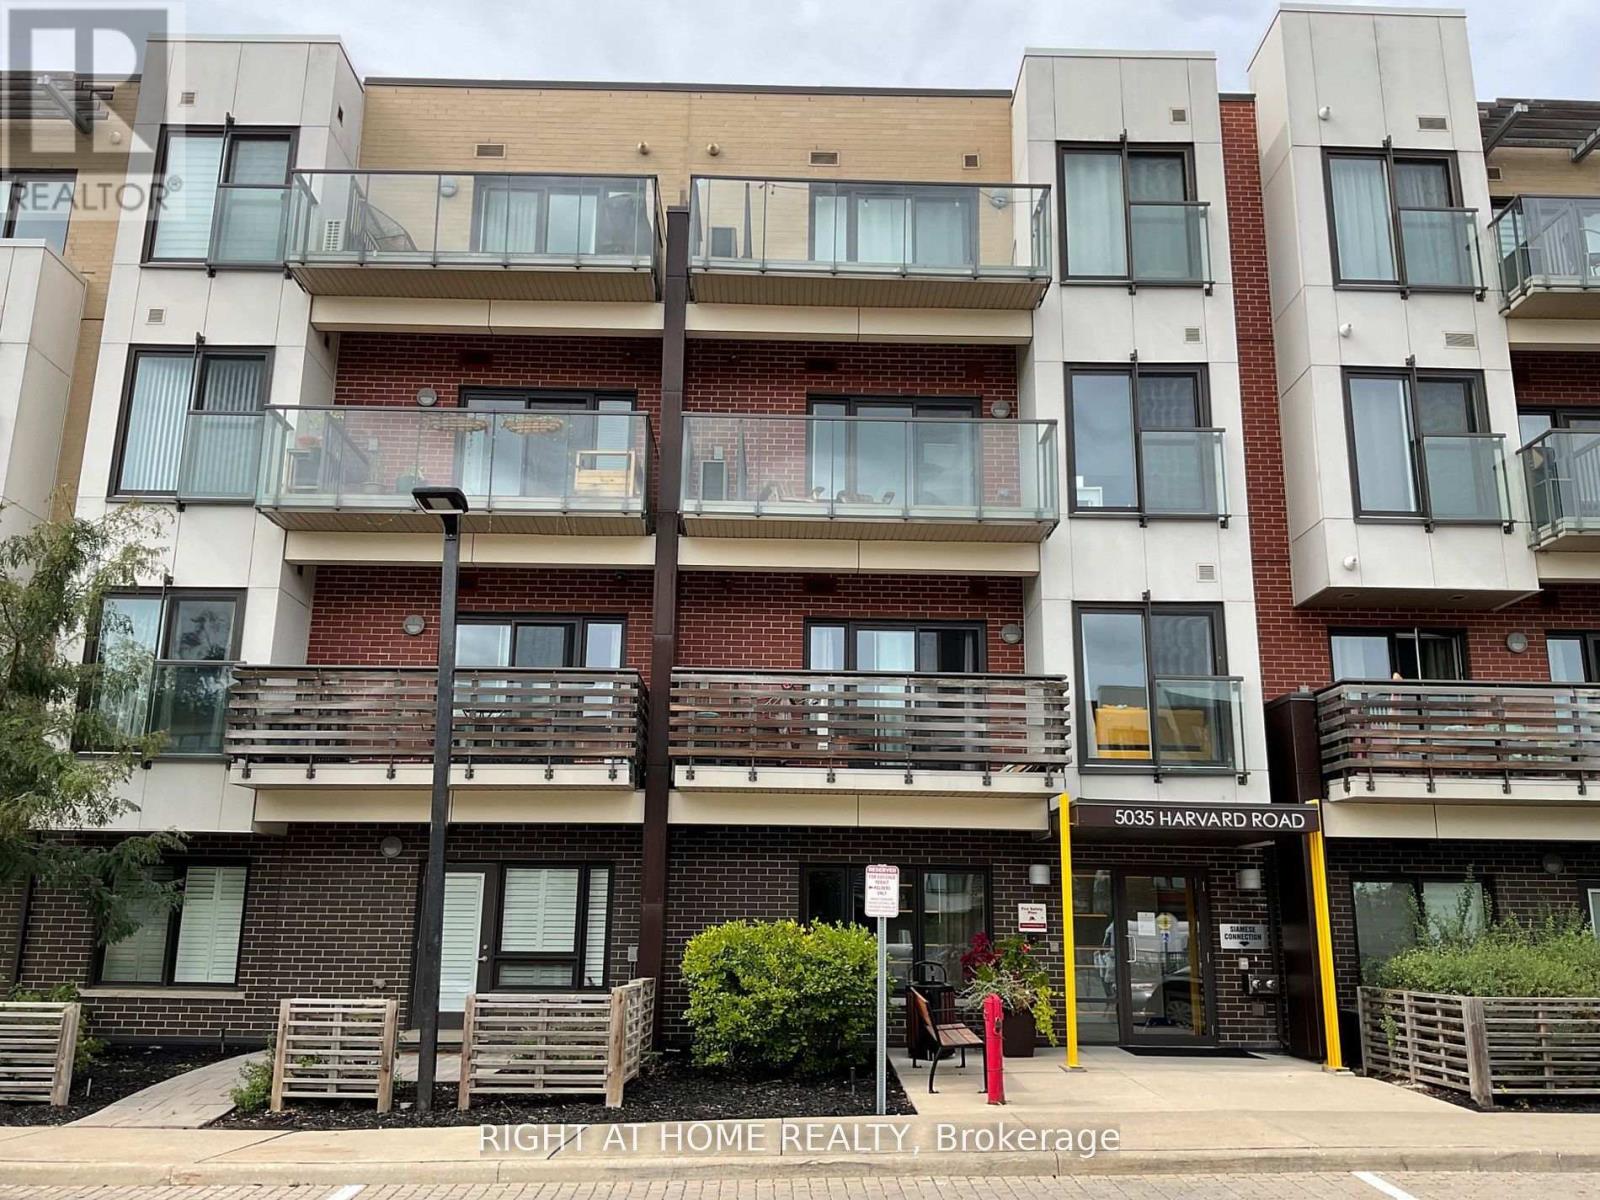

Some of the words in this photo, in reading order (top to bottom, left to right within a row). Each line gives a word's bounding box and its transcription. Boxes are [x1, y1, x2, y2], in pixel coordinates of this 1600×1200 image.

[1114, 809, 1154, 826] 5035
[1159, 811, 1247, 828] HARVARD
[1252, 813, 1305, 829] ROAD
